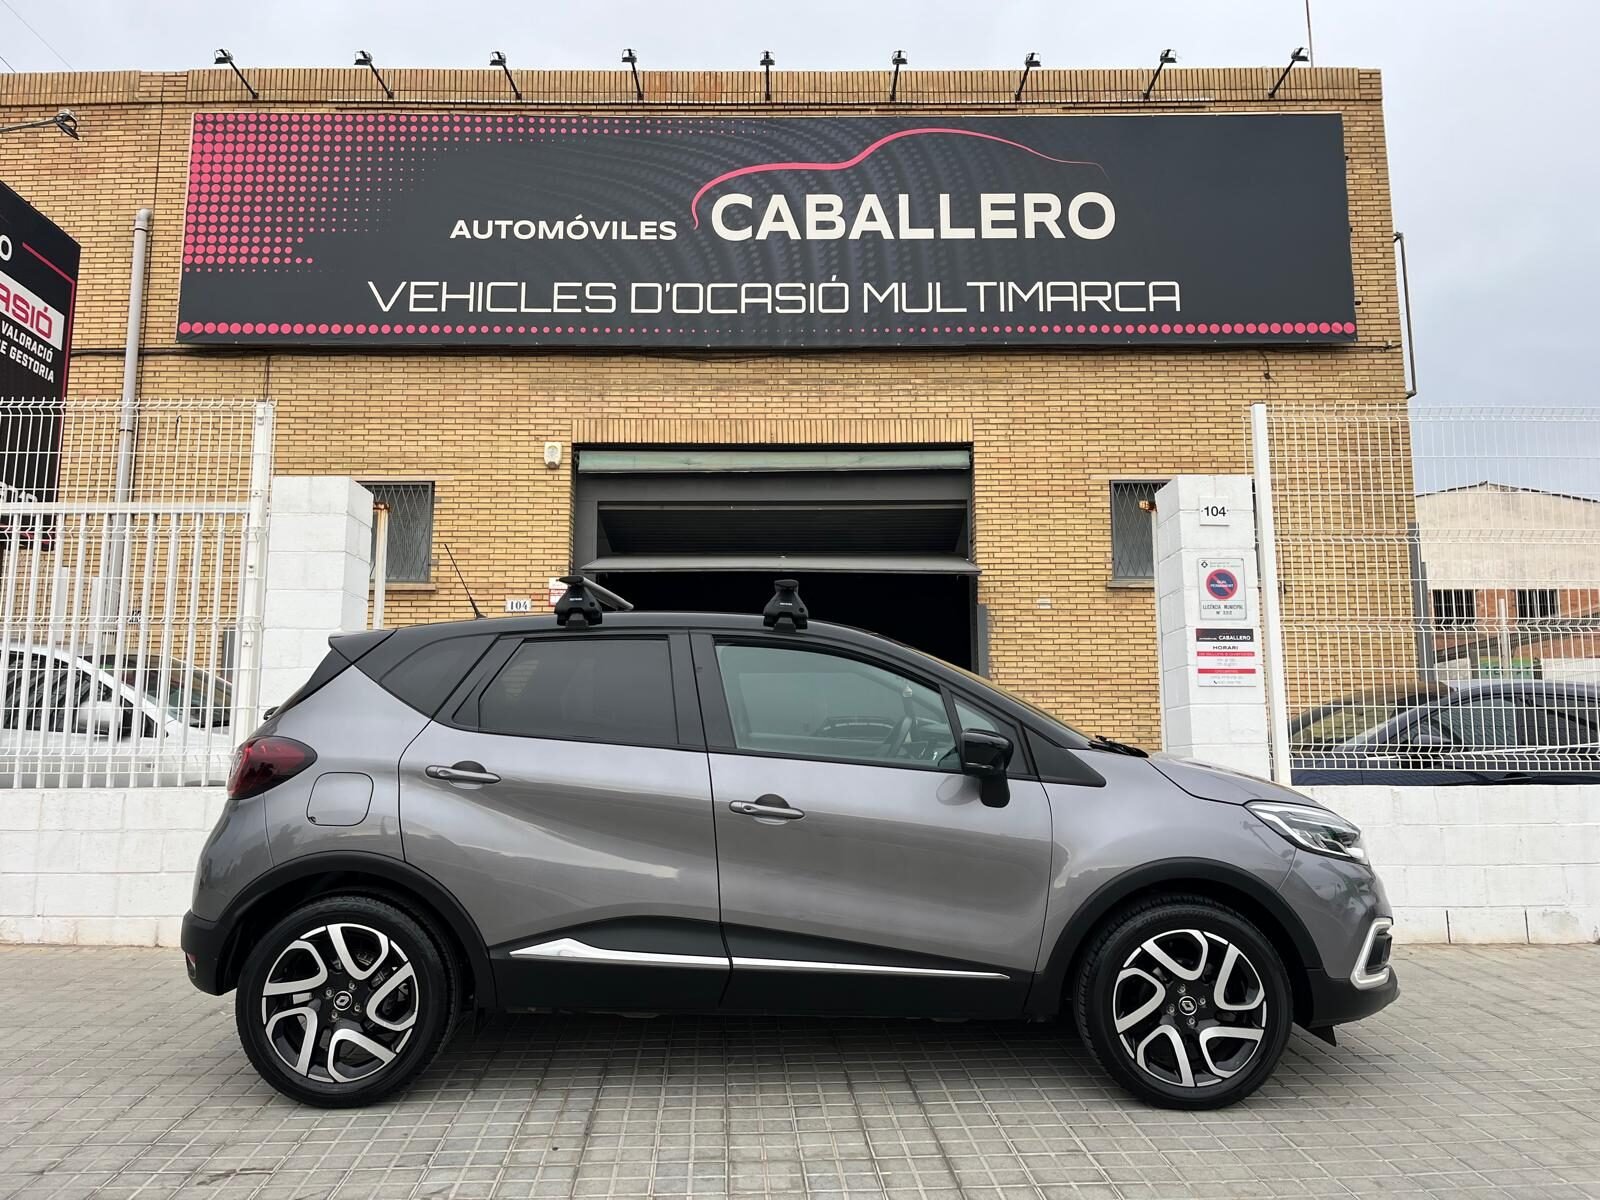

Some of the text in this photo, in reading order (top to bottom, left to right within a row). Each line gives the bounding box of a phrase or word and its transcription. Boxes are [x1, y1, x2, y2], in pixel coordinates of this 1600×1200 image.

[450, 191, 1117, 242] AUTOMÓVILES CABALLERO
[367, 274, 1181, 315] VEHICLES D'OCASIÓ MULTIMARCA
[1, 319, 54, 363] VALORACIÓ
[9, 344, 55, 384] GESTORIA
[1204, 505, 1227, 517] 104
[510, 600, 528, 611] 104
